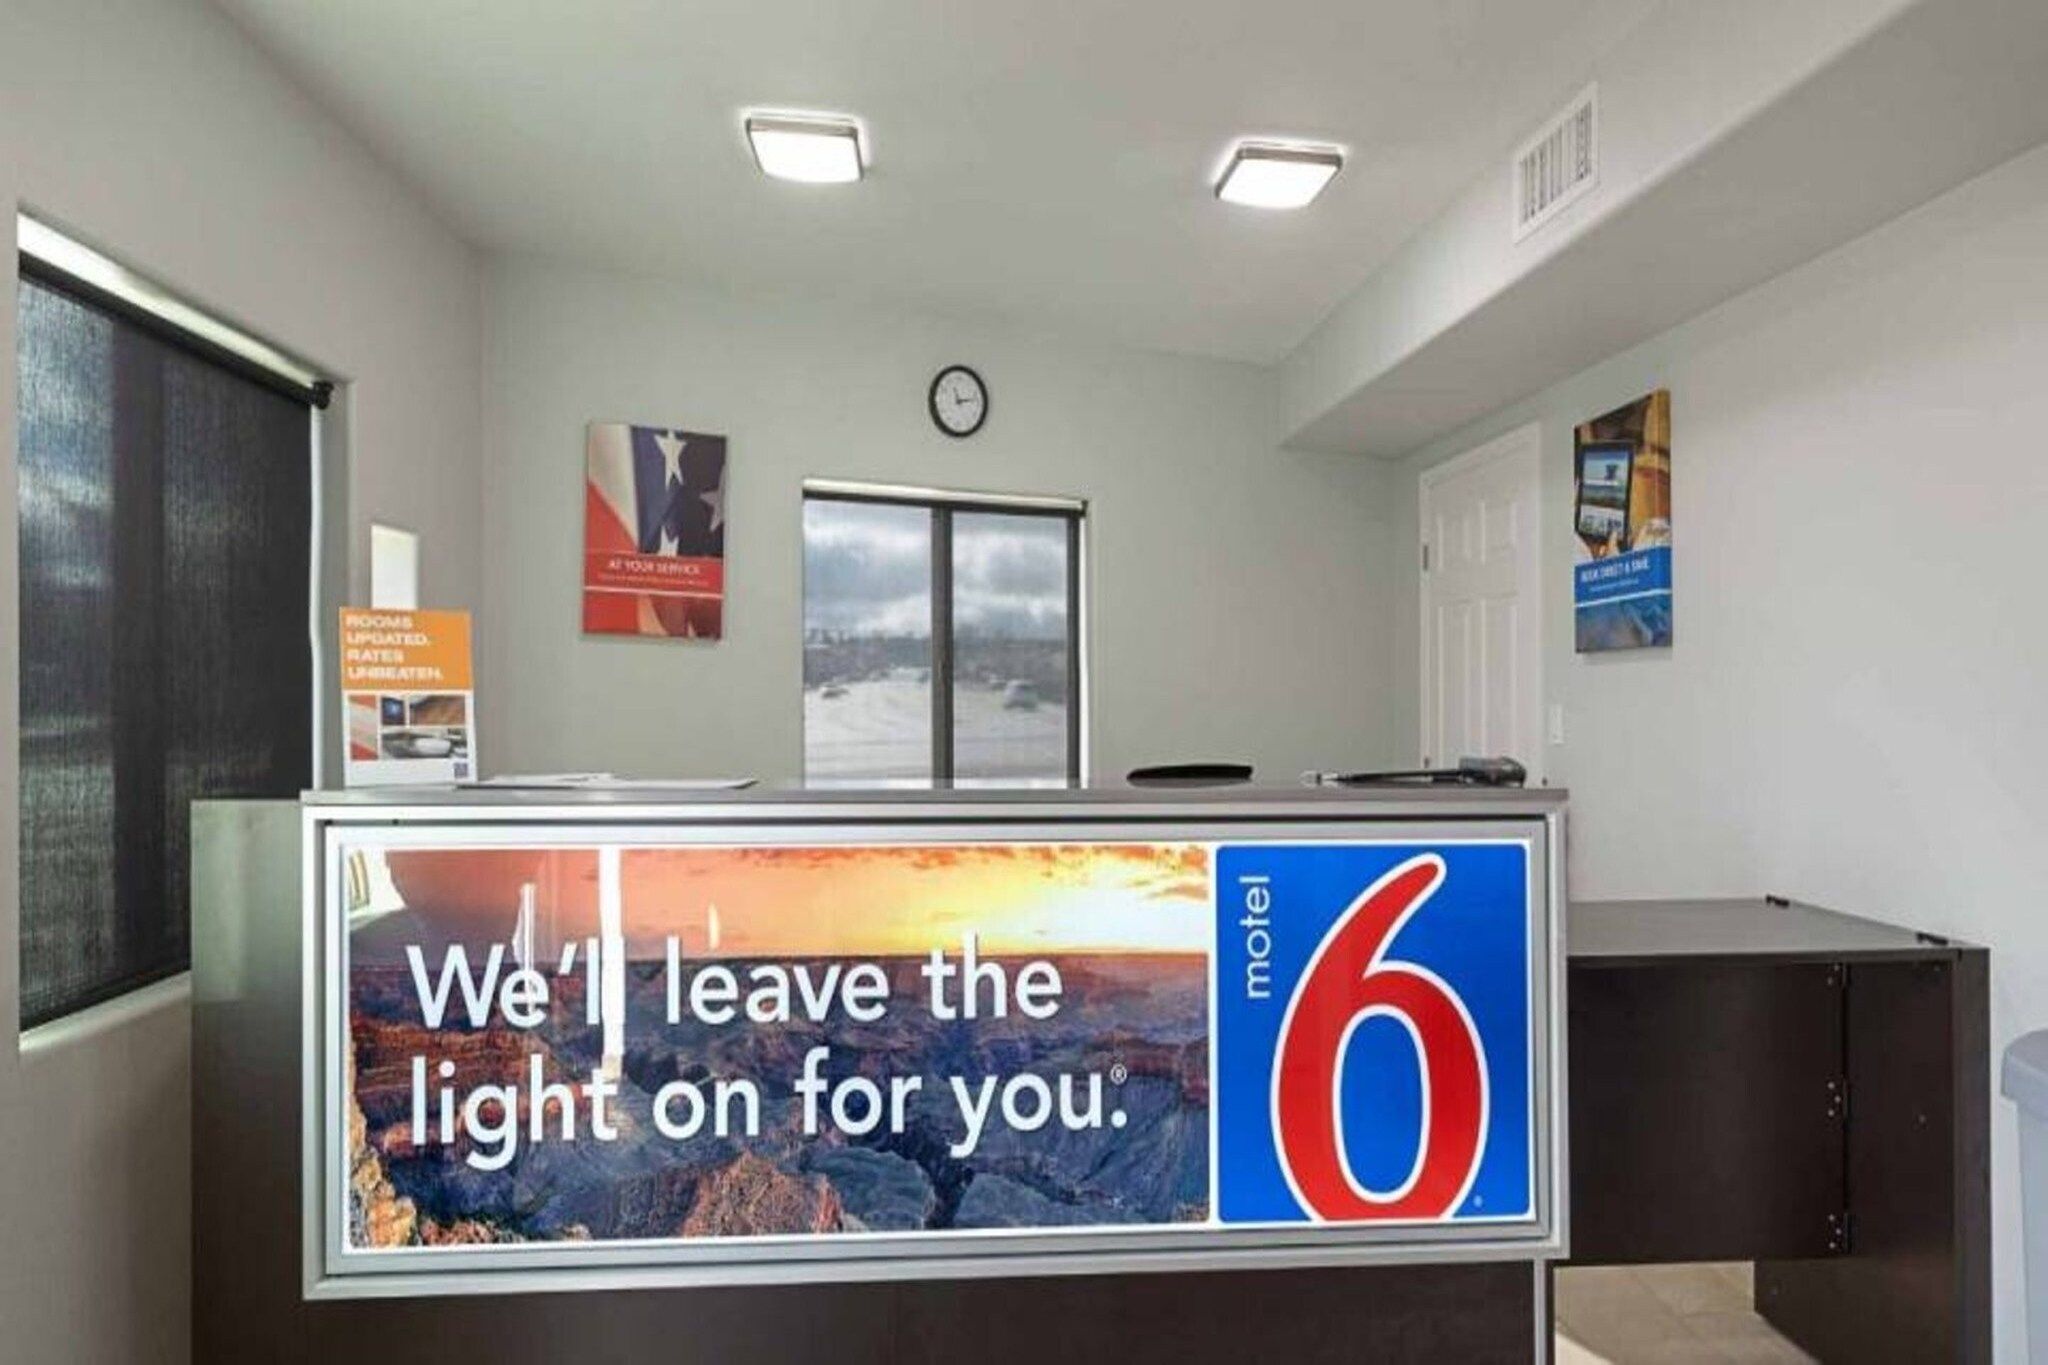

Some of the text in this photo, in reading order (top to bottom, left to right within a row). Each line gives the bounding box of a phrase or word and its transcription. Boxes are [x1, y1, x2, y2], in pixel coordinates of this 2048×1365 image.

[625, 560, 654, 573] YOUR
[346, 615, 413, 629] ROOMS
[346, 648, 405, 664] RATES
[666, 935, 890, 1025] leave
[921, 929, 1063, 1020] the
[1238, 874, 1271, 999] motel
[1270, 852, 1490, 1222] 6
[412, 1053, 618, 1171] light
[653, 1076, 760, 1140] on
[794, 1046, 923, 1135] for
